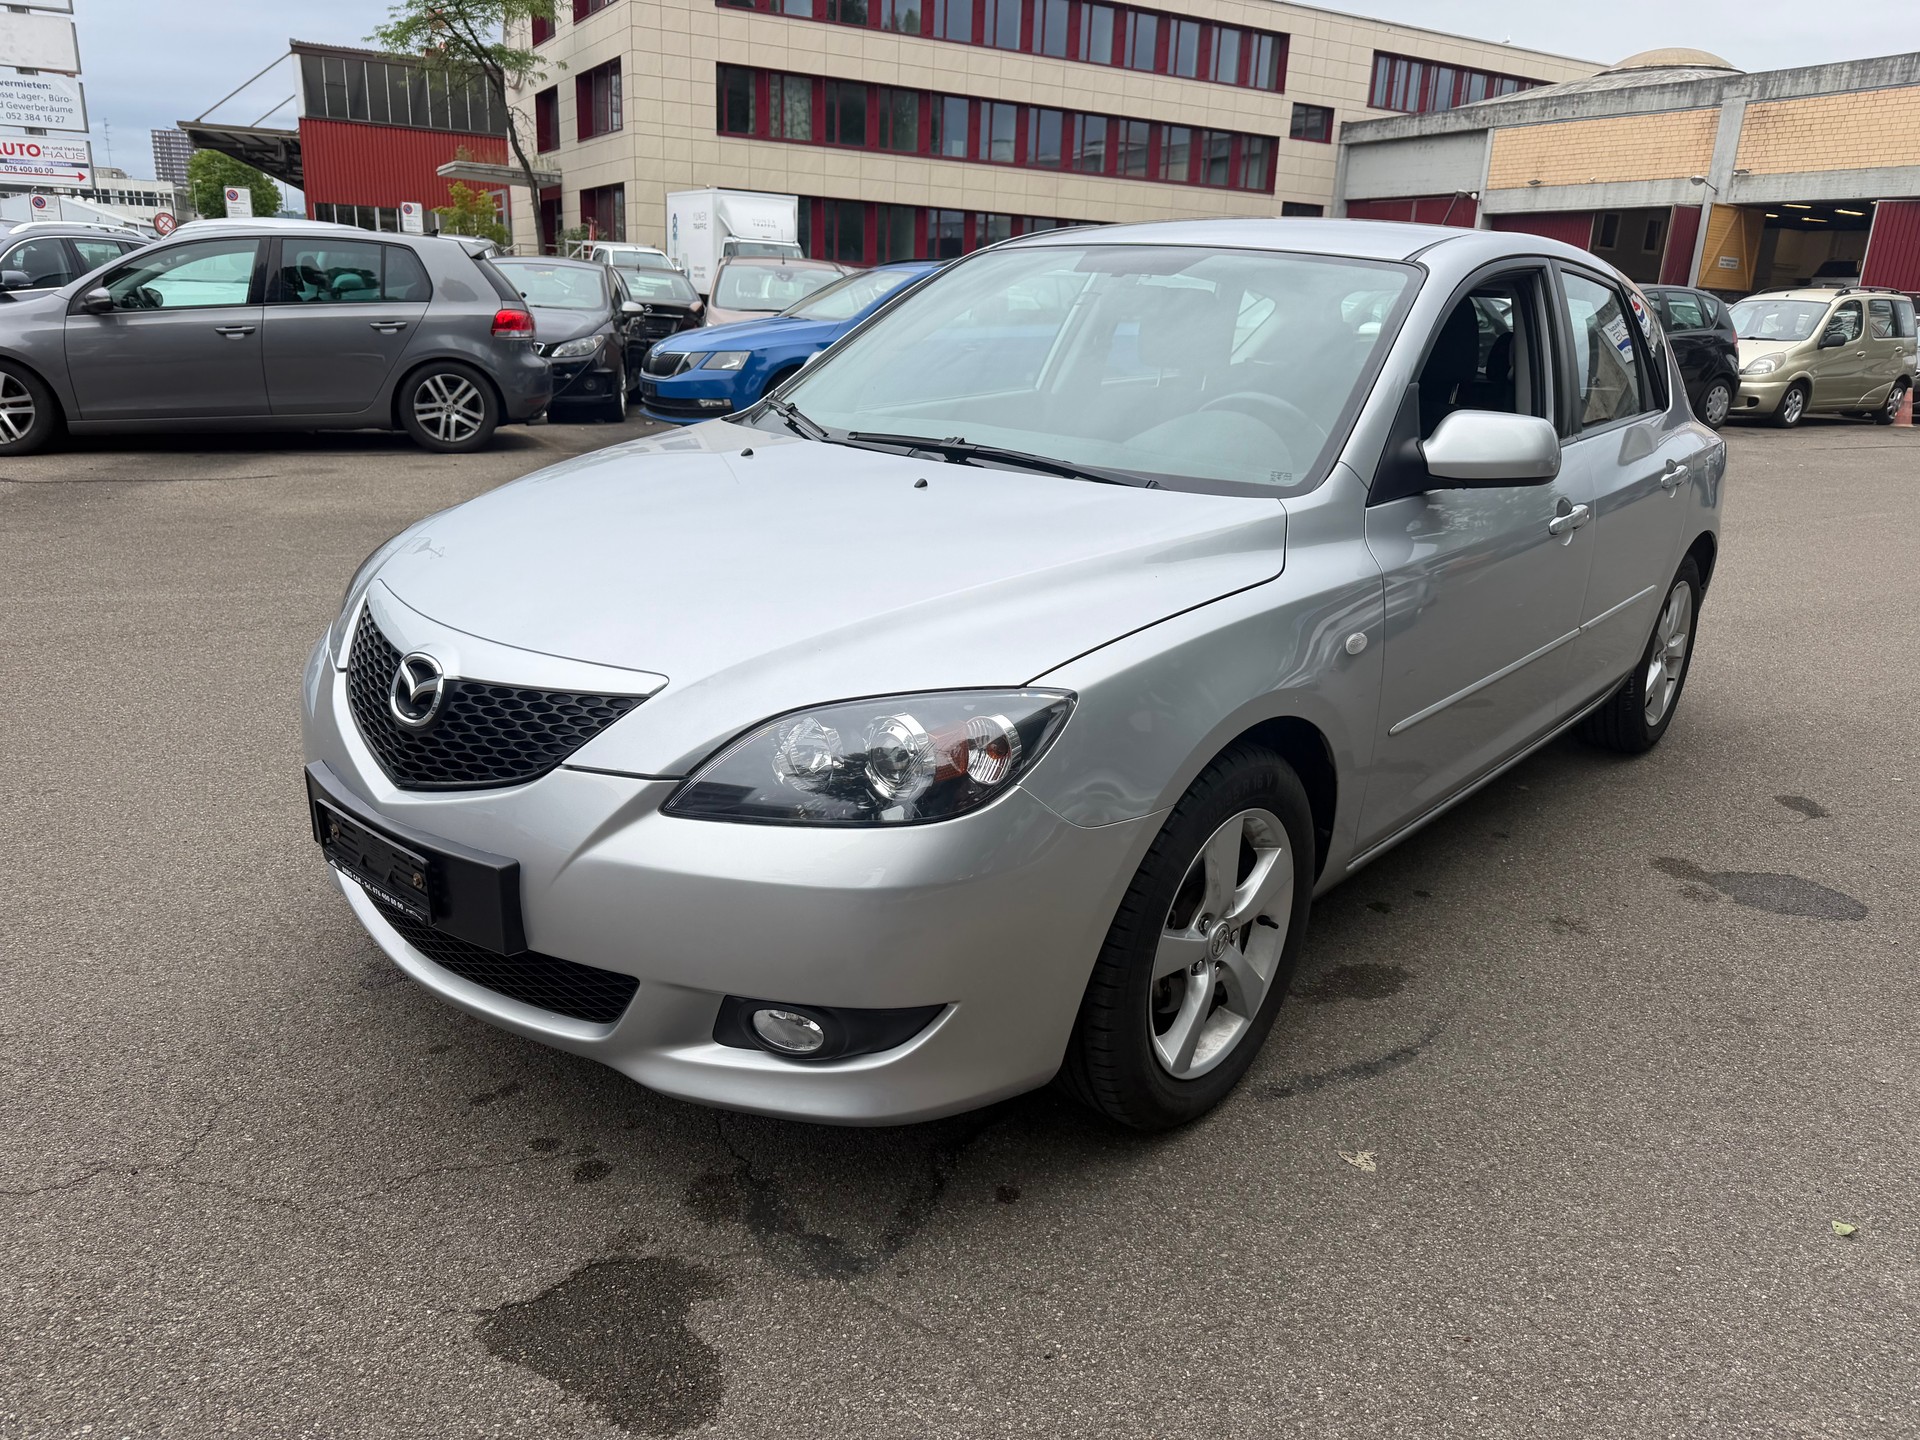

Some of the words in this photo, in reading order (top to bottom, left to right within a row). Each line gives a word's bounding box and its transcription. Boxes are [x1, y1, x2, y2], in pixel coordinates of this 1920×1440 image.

[16, 92, 46, 102] Lager-,
[48, 94, 72, 102] Büro-
[6, 102, 74, 114] Gewerberäume
[6, 112, 22, 120] 052
[24, 113, 40, 121] 384
[0, 142, 41, 157] UTO
[43, 151, 86, 160] HAUS
